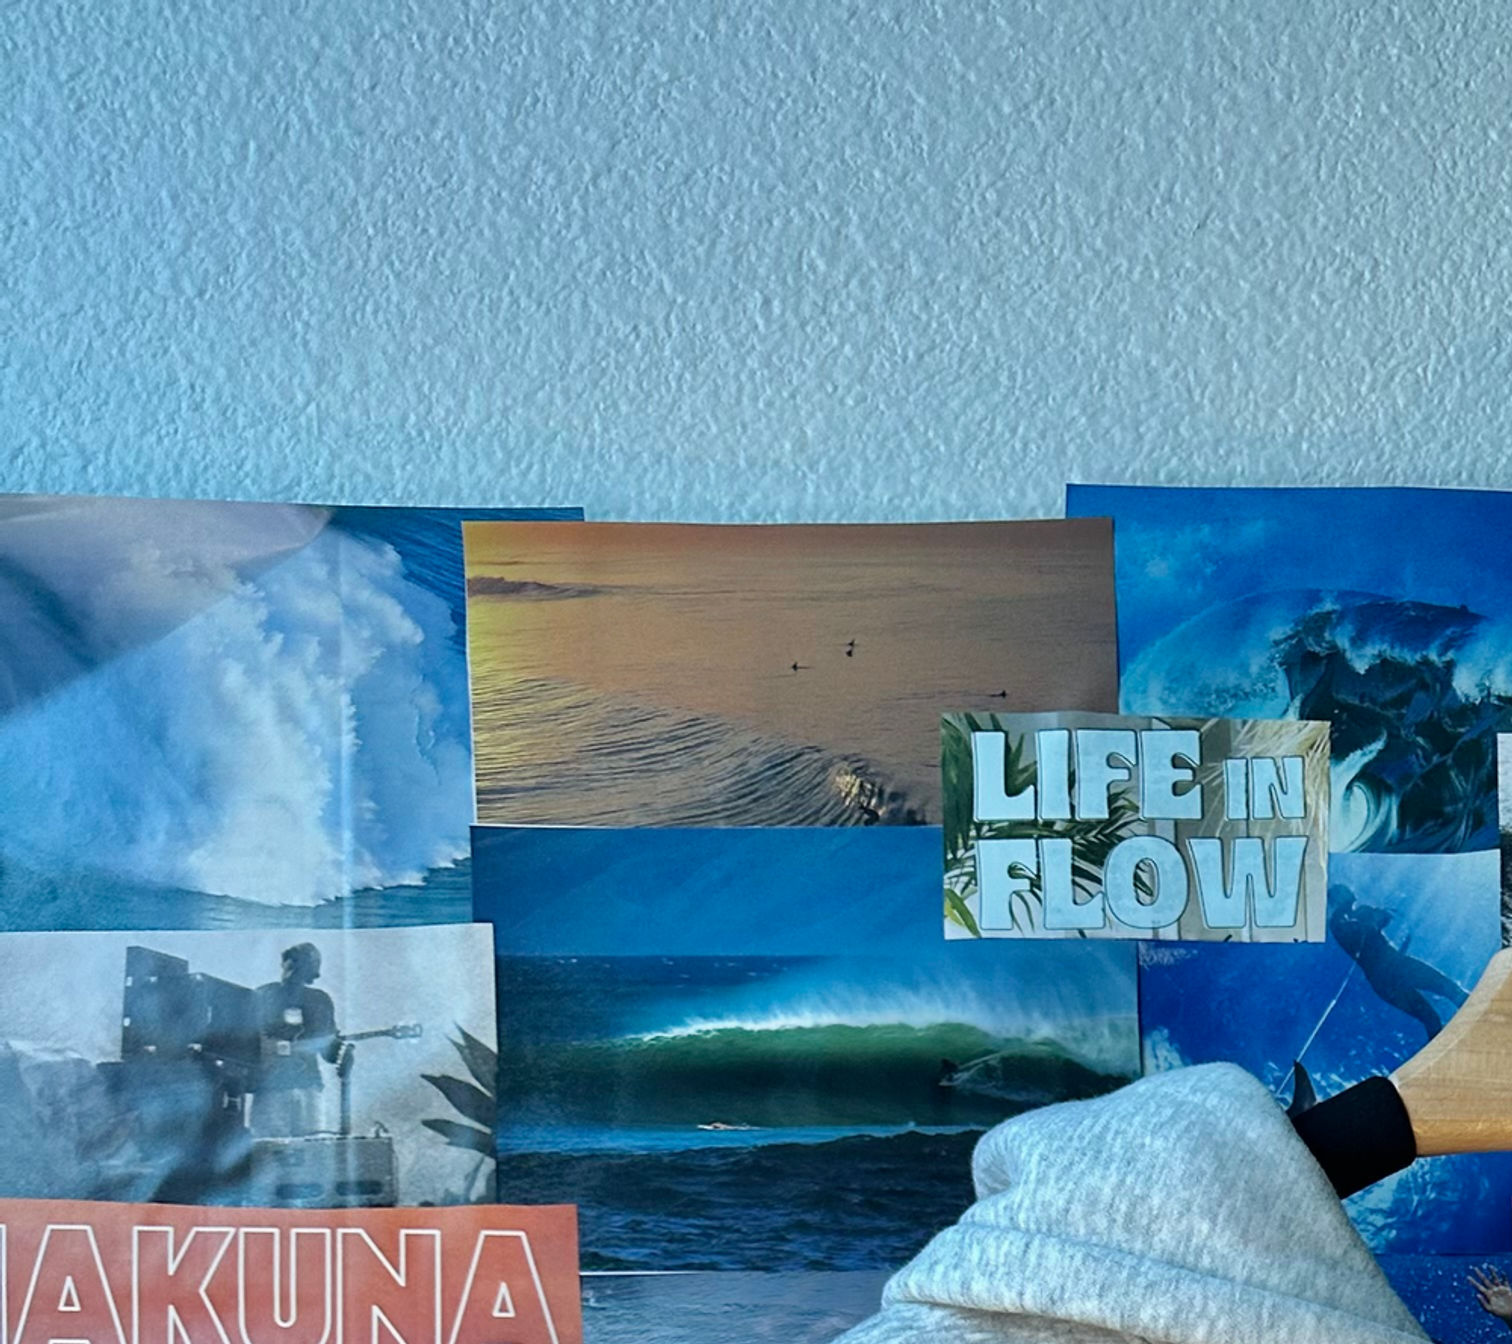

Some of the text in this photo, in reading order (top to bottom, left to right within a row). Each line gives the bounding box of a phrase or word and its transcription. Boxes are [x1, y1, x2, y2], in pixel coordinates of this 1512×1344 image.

[972, 729, 1306, 821] LIFE IN
[976, 835, 1309, 930] FLOW
